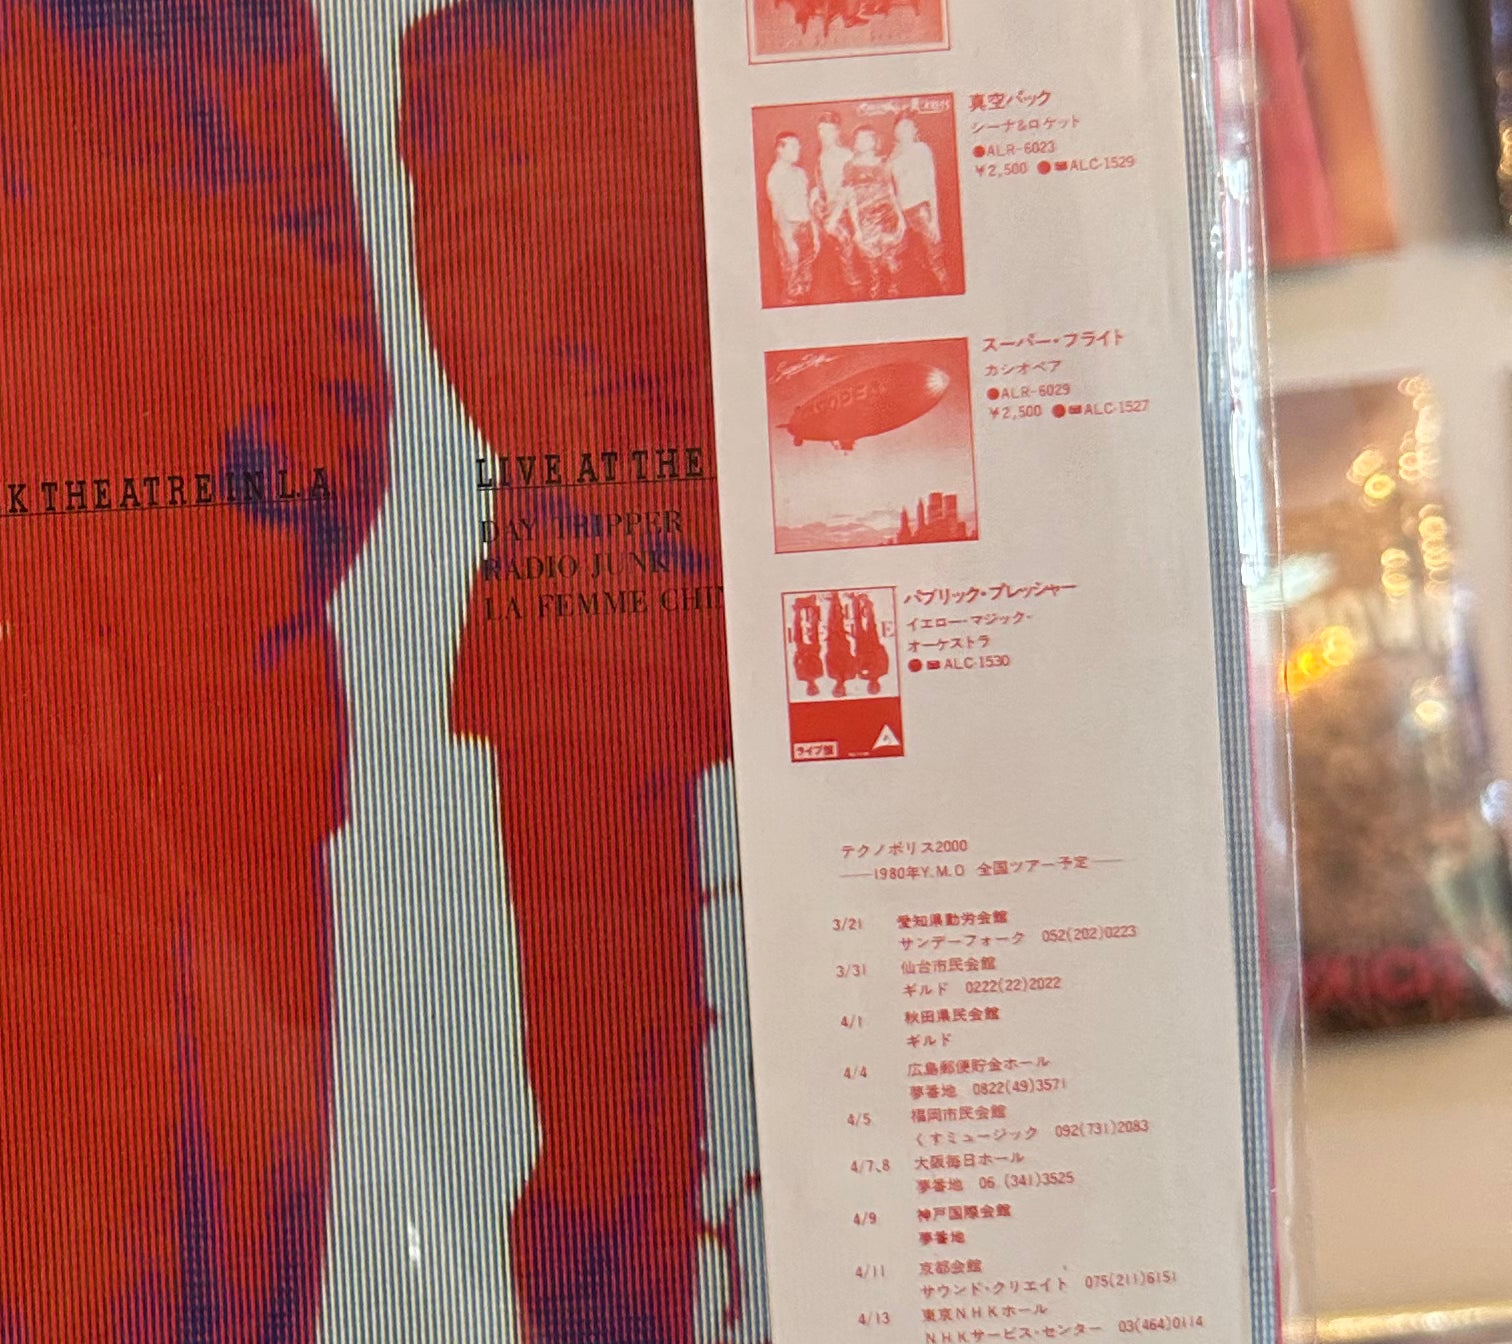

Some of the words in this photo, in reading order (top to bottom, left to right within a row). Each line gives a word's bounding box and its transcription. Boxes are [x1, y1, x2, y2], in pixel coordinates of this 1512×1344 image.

[982, 328, 1124, 352] スーパー・フライト
[476, 454, 562, 489] LIVE
[577, 451, 618, 484] AT
[632, 447, 704, 480] THE
[41, 473, 214, 512] THEATRE
[226, 470, 264, 501] IN
[481, 517, 537, 544] DAY
[482, 555, 579, 582] RADIO
[590, 551, 670, 579] JUNK
[487, 597, 522, 621] LA
[537, 590, 649, 618] FEMME
[908, 635, 990, 652] オーケストラ
[841, 840, 968, 858] テクノポリス2000
[832, 918, 863, 931] 3/21
[836, 964, 867, 978] 3/31
[901, 956, 996, 975] 仙台市民会館
[843, 1065, 868, 1080] 4/4
[847, 1113, 872, 1126] 4/5
[853, 1212, 877, 1226] 4/9
[856, 1264, 886, 1279] 4/11
[920, 1258, 983, 1276] 京都会館
[858, 1312, 891, 1326] 4/13
